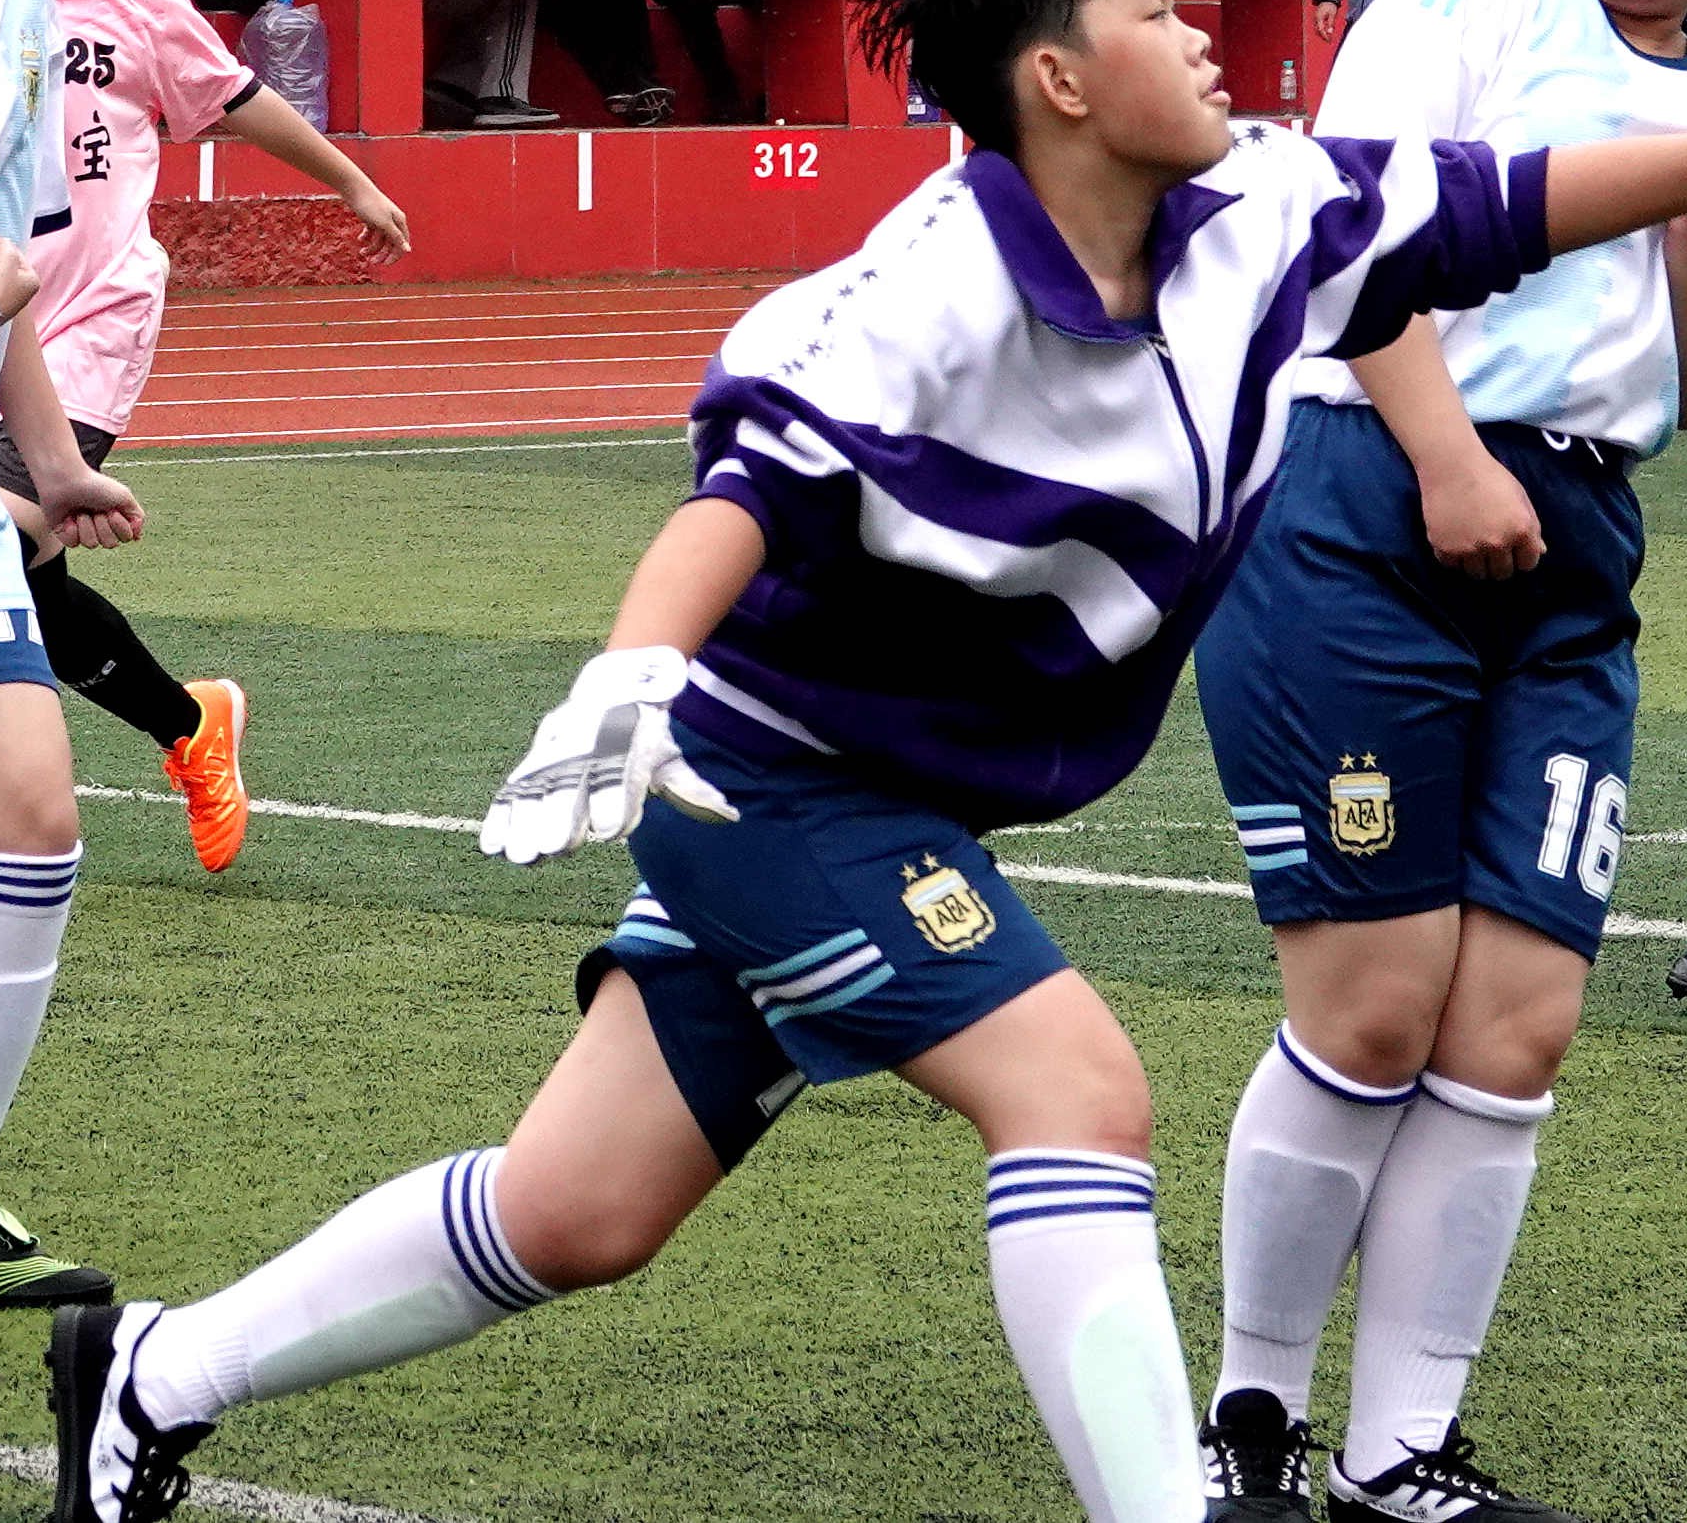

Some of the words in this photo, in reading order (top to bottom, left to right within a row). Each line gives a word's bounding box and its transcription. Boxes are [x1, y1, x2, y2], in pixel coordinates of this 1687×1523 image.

[64, 37, 116, 89] 25
[71, 110, 111, 183] 宝
[754, 142, 818, 178] 312
[1537, 752, 1629, 904] 16
